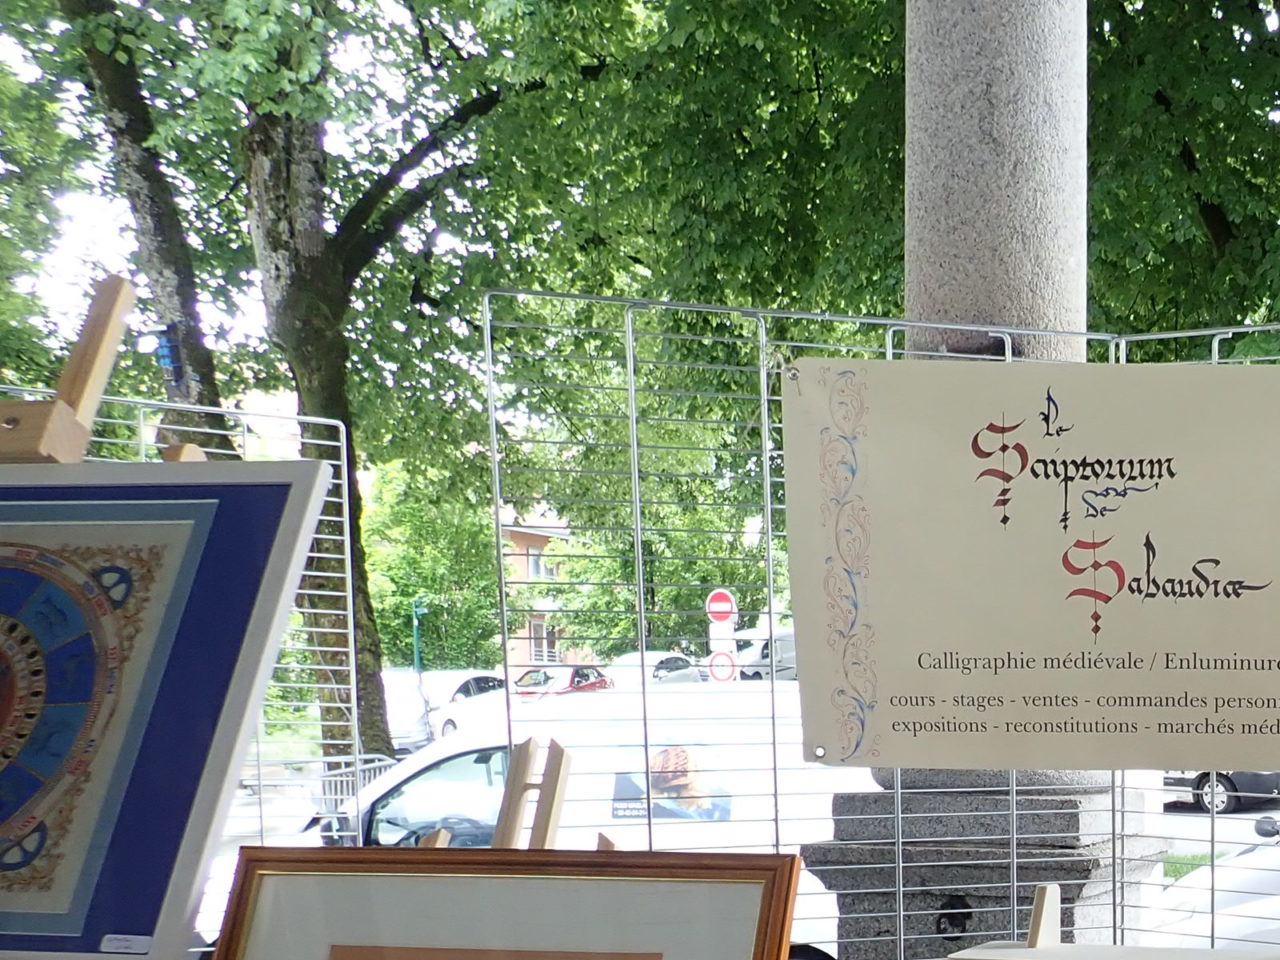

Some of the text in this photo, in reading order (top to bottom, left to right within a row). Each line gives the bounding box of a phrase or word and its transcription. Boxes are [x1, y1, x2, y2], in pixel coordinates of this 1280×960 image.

[1038, 385, 1075, 439] Le
[971, 411, 1178, 533] Scriptorium
[917, 651, 1037, 676] Calligraphie
[1043, 651, 1144, 670] médiévale
[889, 694, 936, 708] cours
[952, 692, 1005, 713] stages
[1021, 692, 1079, 708] ventes
[1096, 690, 1208, 709] commandes
[891, 716, 988, 738] expositions
[1004, 716, 1138, 734] reconstitutions
[1156, 717, 1235, 735] marchés
